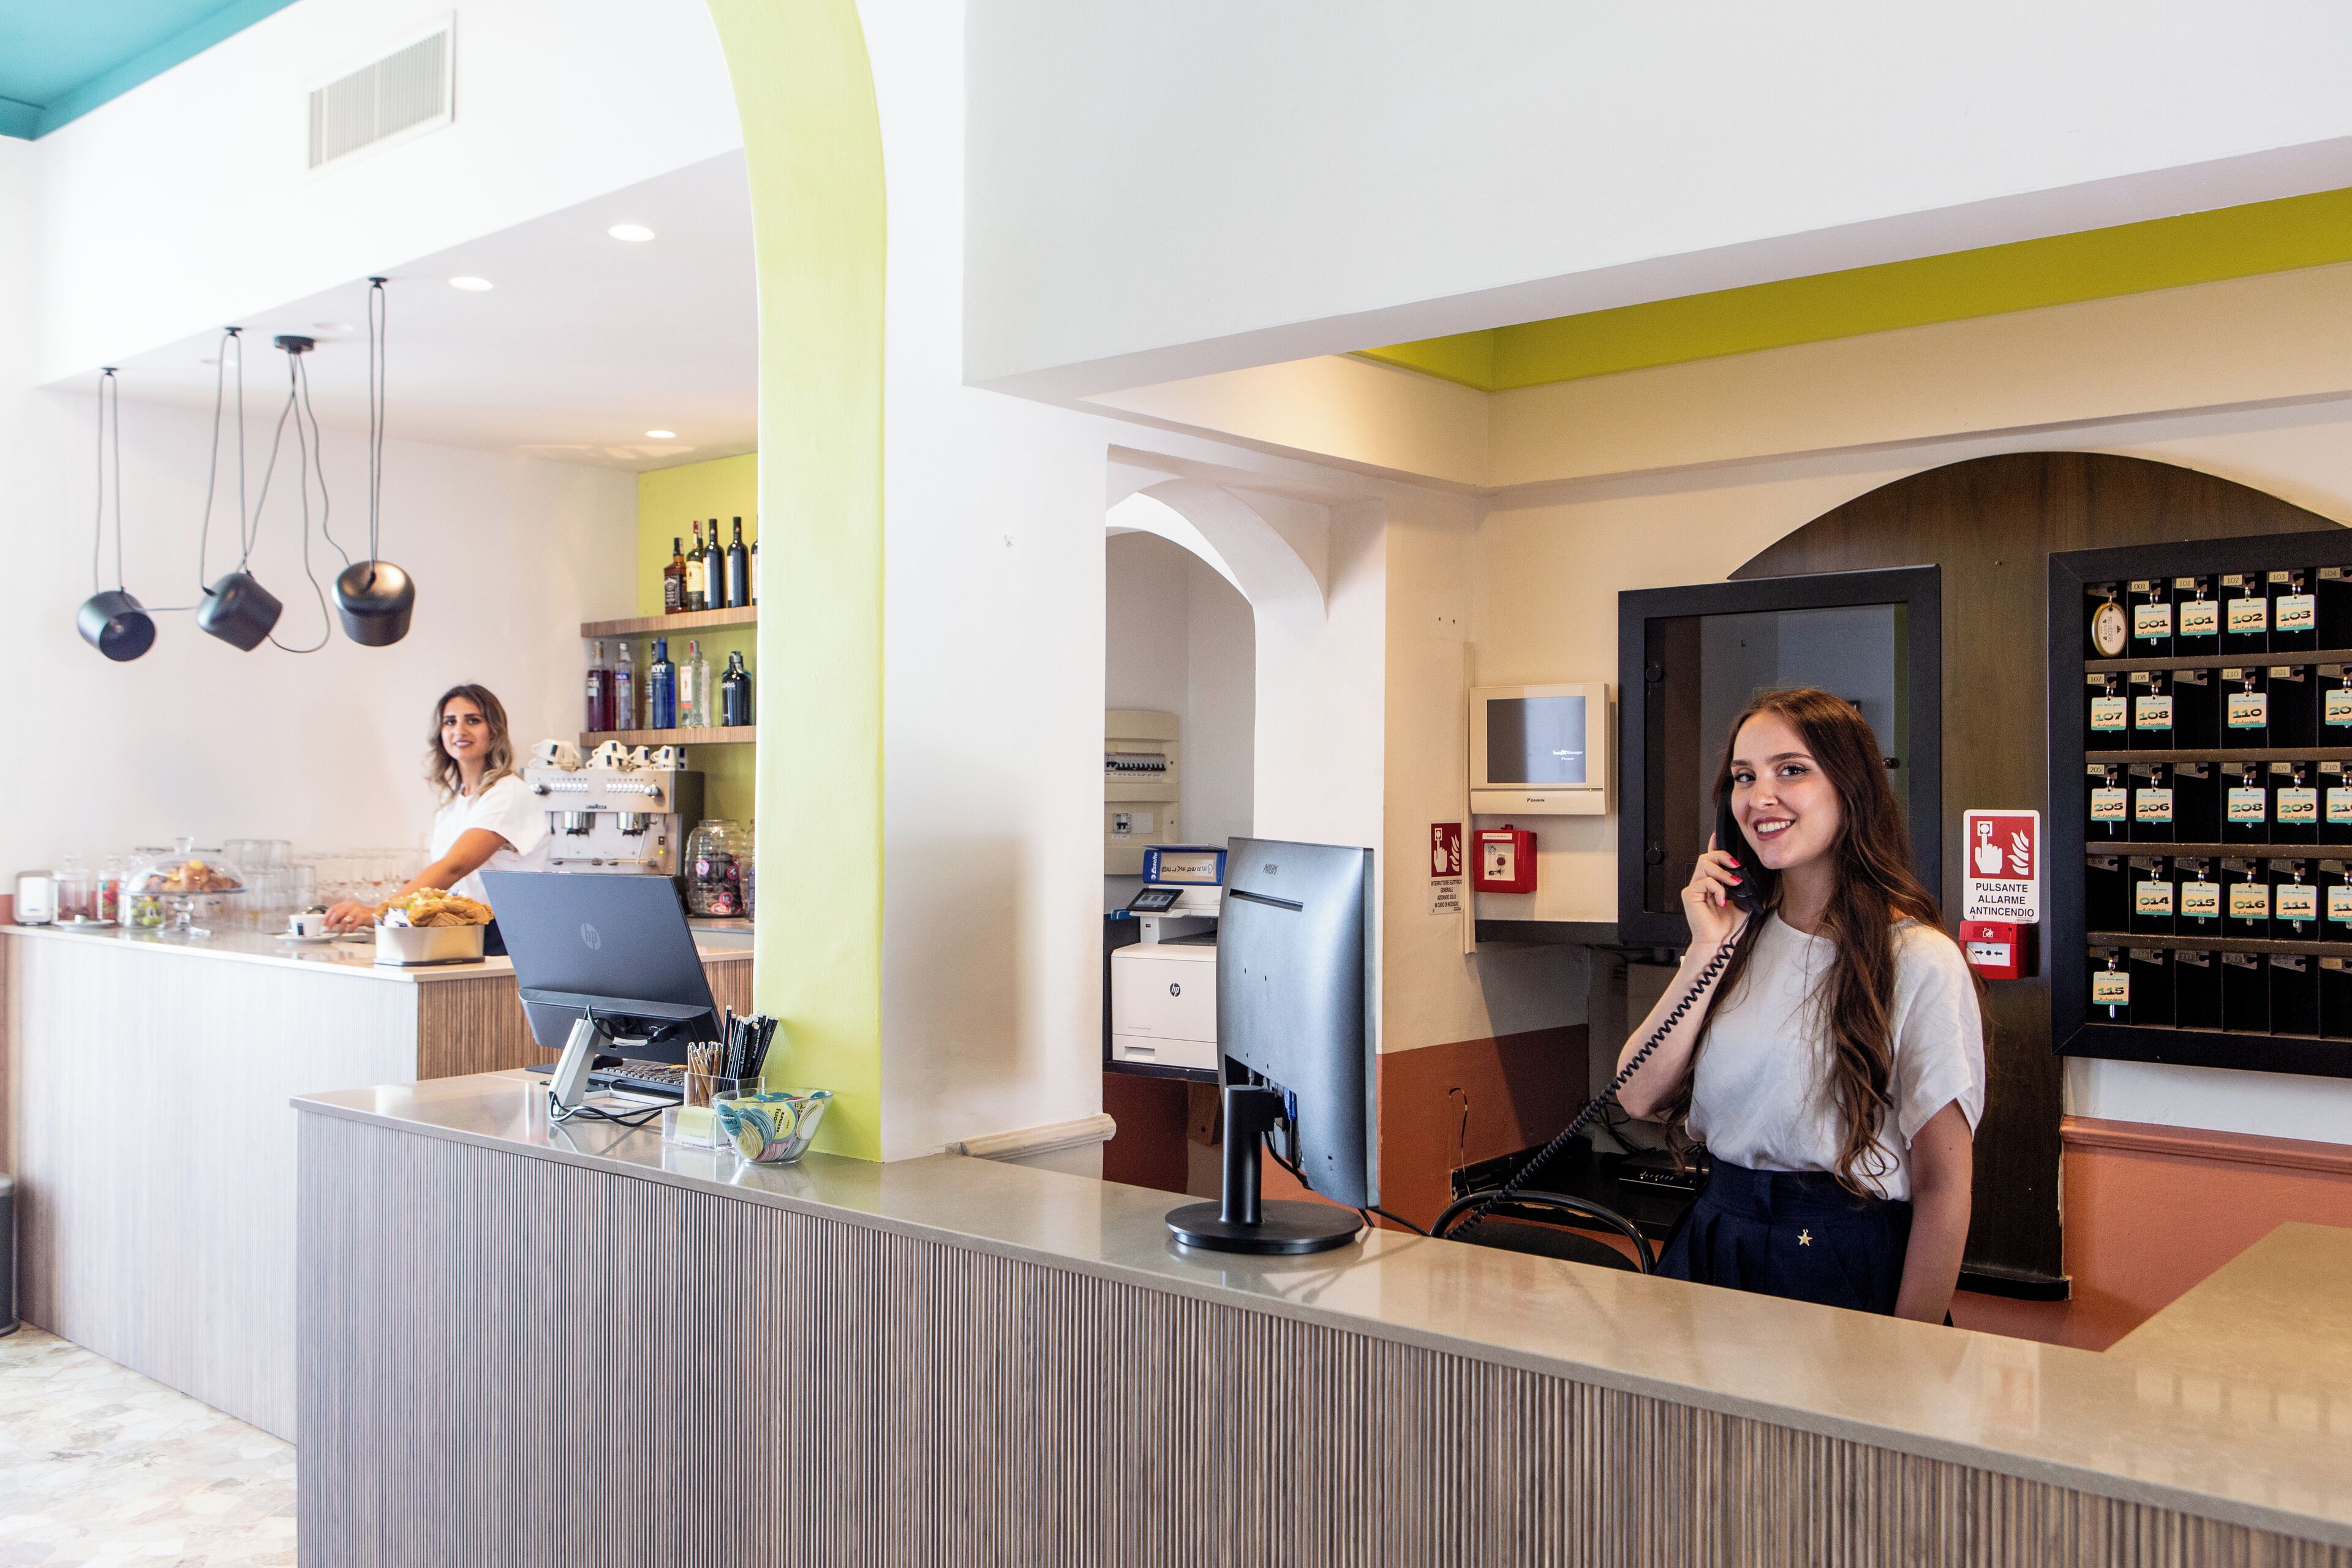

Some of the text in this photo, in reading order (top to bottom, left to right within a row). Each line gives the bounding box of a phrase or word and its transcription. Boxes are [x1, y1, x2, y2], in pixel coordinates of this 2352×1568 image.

[2185, 616, 2214, 626] 101
[2232, 613, 2263, 624] 102
[2280, 610, 2311, 622] 103
[2138, 619, 2168, 630] 001
[2139, 710, 2169, 720] 108
[2233, 708, 2262, 718] 110
[2329, 706, 2352, 715] 20
[2095, 712, 2122, 722] 107
[2094, 802, 2124, 812] 205
[2138, 803, 2169, 813] 206
[2231, 803, 2263, 813] 208
[2280, 803, 2314, 813] 209
[2330, 803, 2352, 813] 21
[1976, 883, 2028, 892] PULSANTE
[1978, 895, 2026, 905] ALLARME
[2139, 896, 2169, 905] 014
[2185, 899, 2215, 907] 015
[2234, 900, 2266, 909] 016
[2283, 901, 2310, 910] 111
[1969, 906, 2034, 917] ANTINCENDIO
[582, 922, 600, 950] hp
[1170, 982, 1181, 997] hp
[2098, 987, 2125, 995] 115
